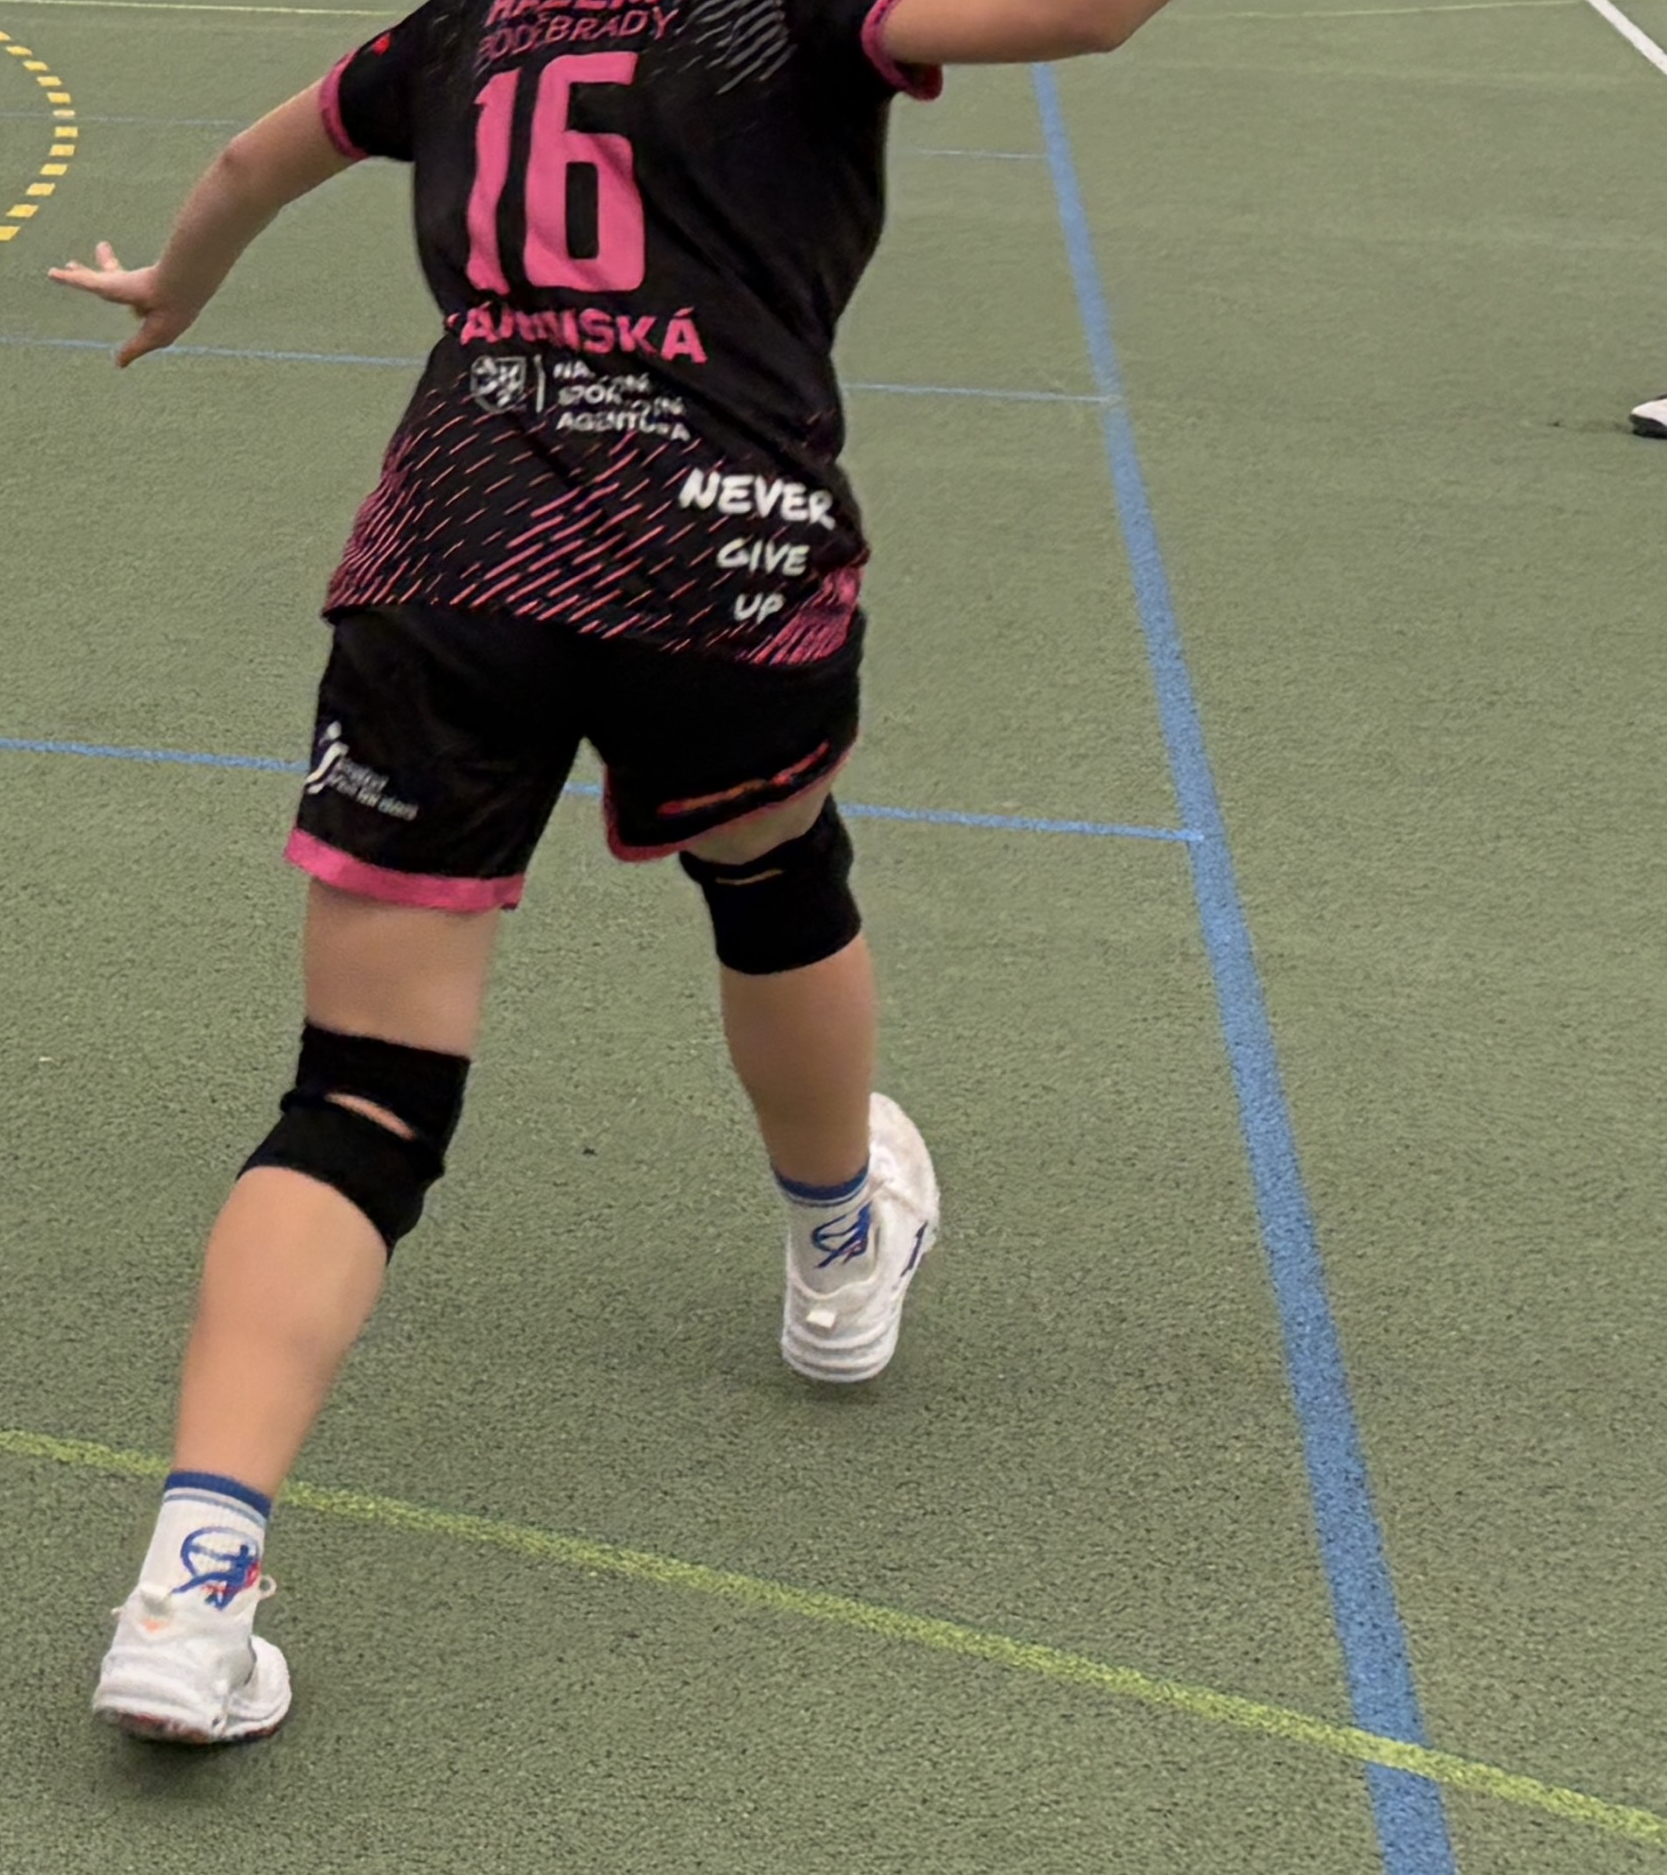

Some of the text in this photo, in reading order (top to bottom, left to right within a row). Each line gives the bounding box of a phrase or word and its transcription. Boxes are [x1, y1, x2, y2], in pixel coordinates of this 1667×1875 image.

[465, 51, 645, 296] 16
[679, 467, 837, 531] NEVER
[716, 536, 810, 577] GIVE
[733, 591, 786, 625] UP
